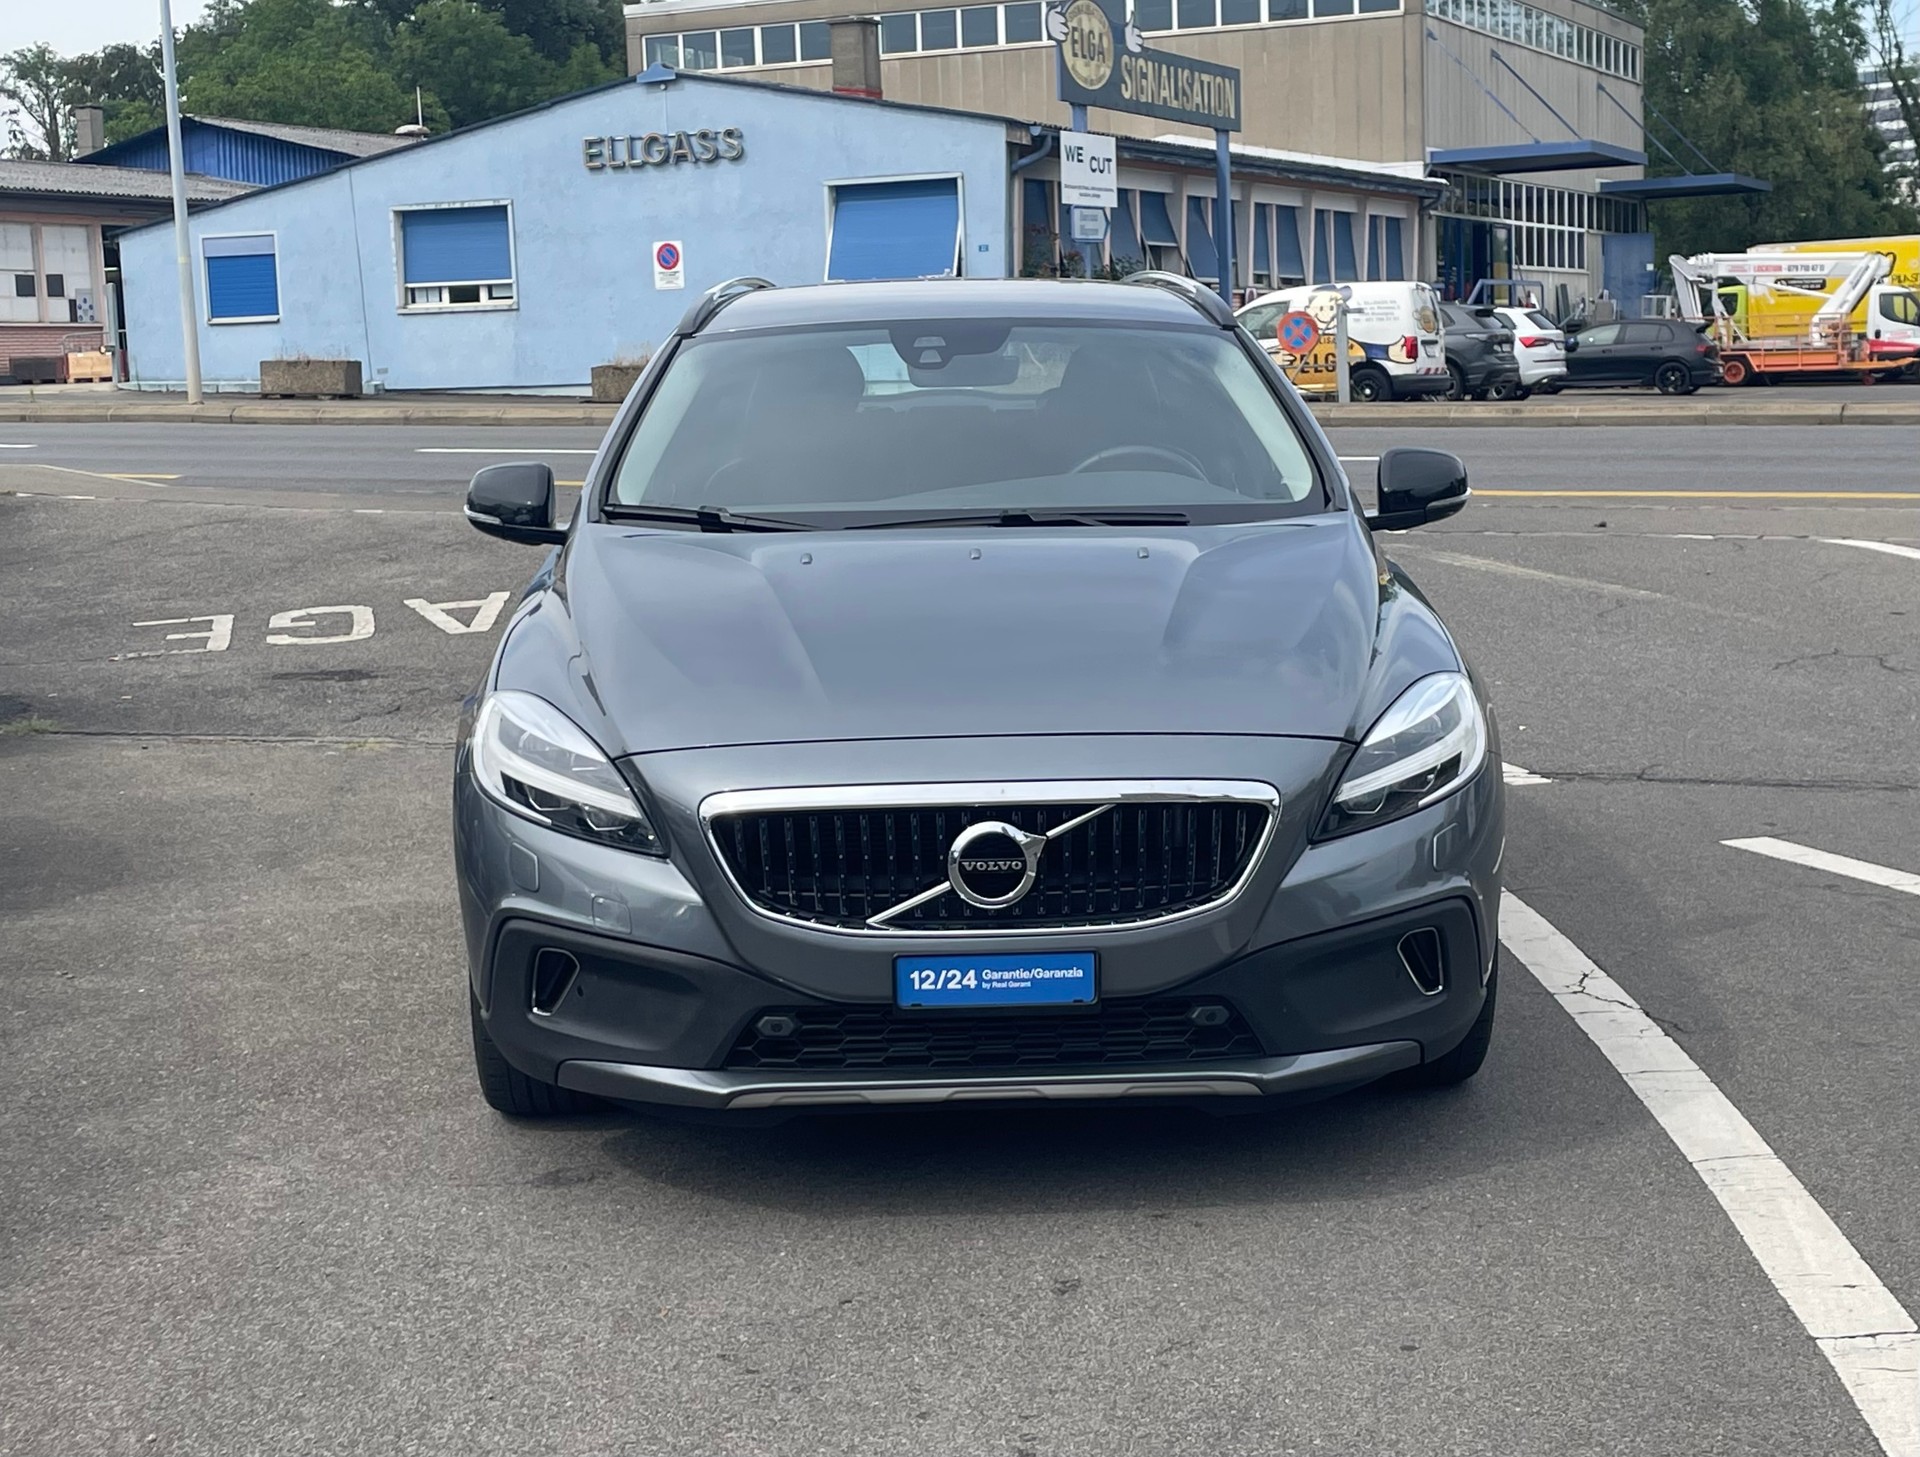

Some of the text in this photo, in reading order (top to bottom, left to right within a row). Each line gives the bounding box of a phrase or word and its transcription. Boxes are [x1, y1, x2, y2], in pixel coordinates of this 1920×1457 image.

[1071, 26, 1106, 64] ELGA
[1121, 54, 1235, 119] SIGNALISATION
[583, 127, 744, 168] ELLGASS
[1064, 145, 1083, 163] WE
[1089, 156, 1113, 174] CUT
[1300, 352, 1337, 374] ELG
[961, 860, 1023, 871] VOLVO
[910, 967, 1084, 990] 12/24 Garantie/Garanzia
[982, 981, 991, 989] by
[1008, 980, 1031, 988] Garant
